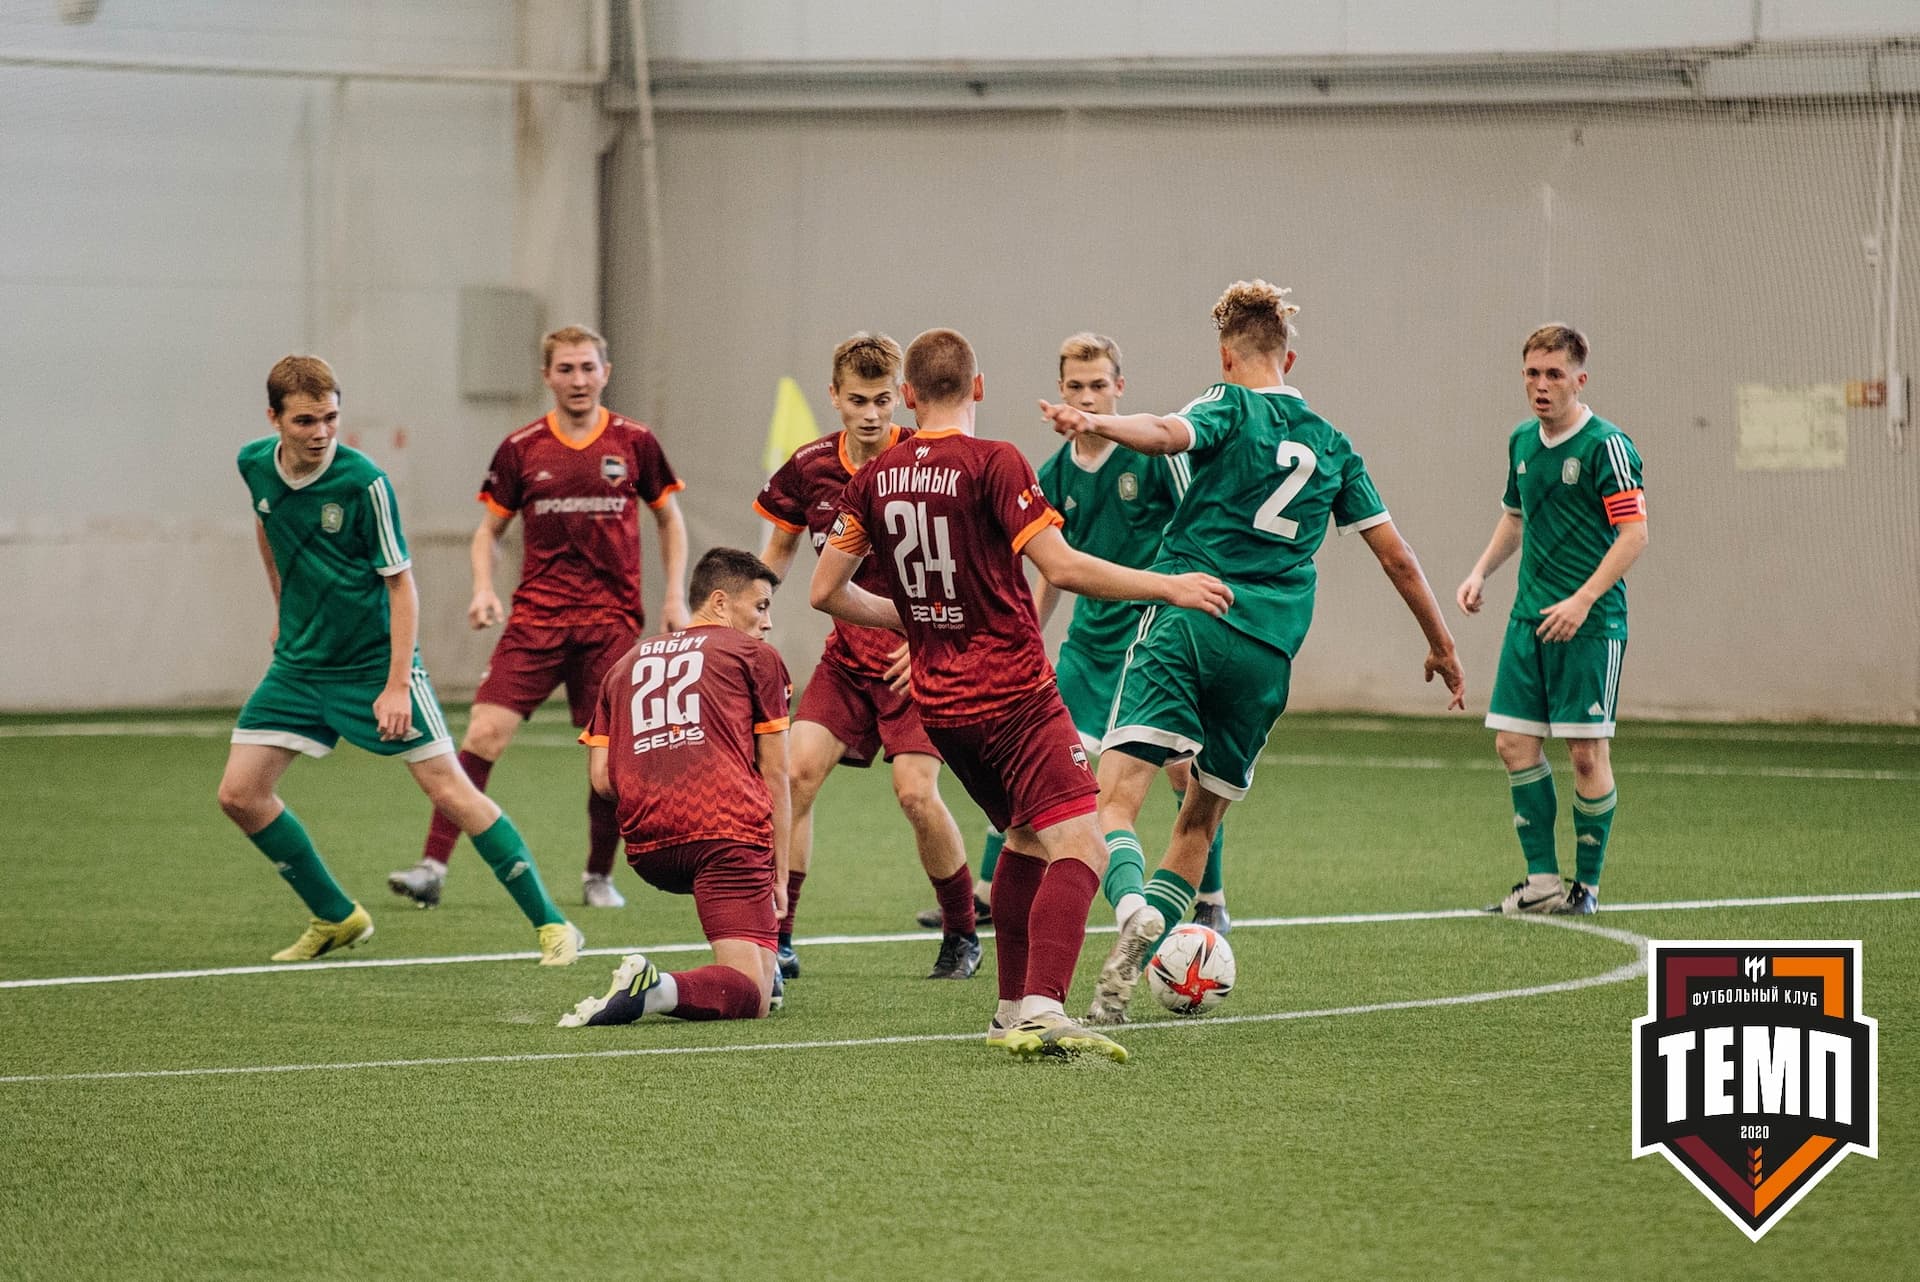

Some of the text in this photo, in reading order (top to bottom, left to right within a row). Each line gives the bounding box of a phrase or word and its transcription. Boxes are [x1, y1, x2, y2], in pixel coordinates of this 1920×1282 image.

[1253, 440, 1317, 539] 2
[884, 500, 957, 599] 24
[640, 635, 708, 656] БАБИЧ
[631, 651, 704, 736] 22
[633, 726, 705, 755] SEUS
